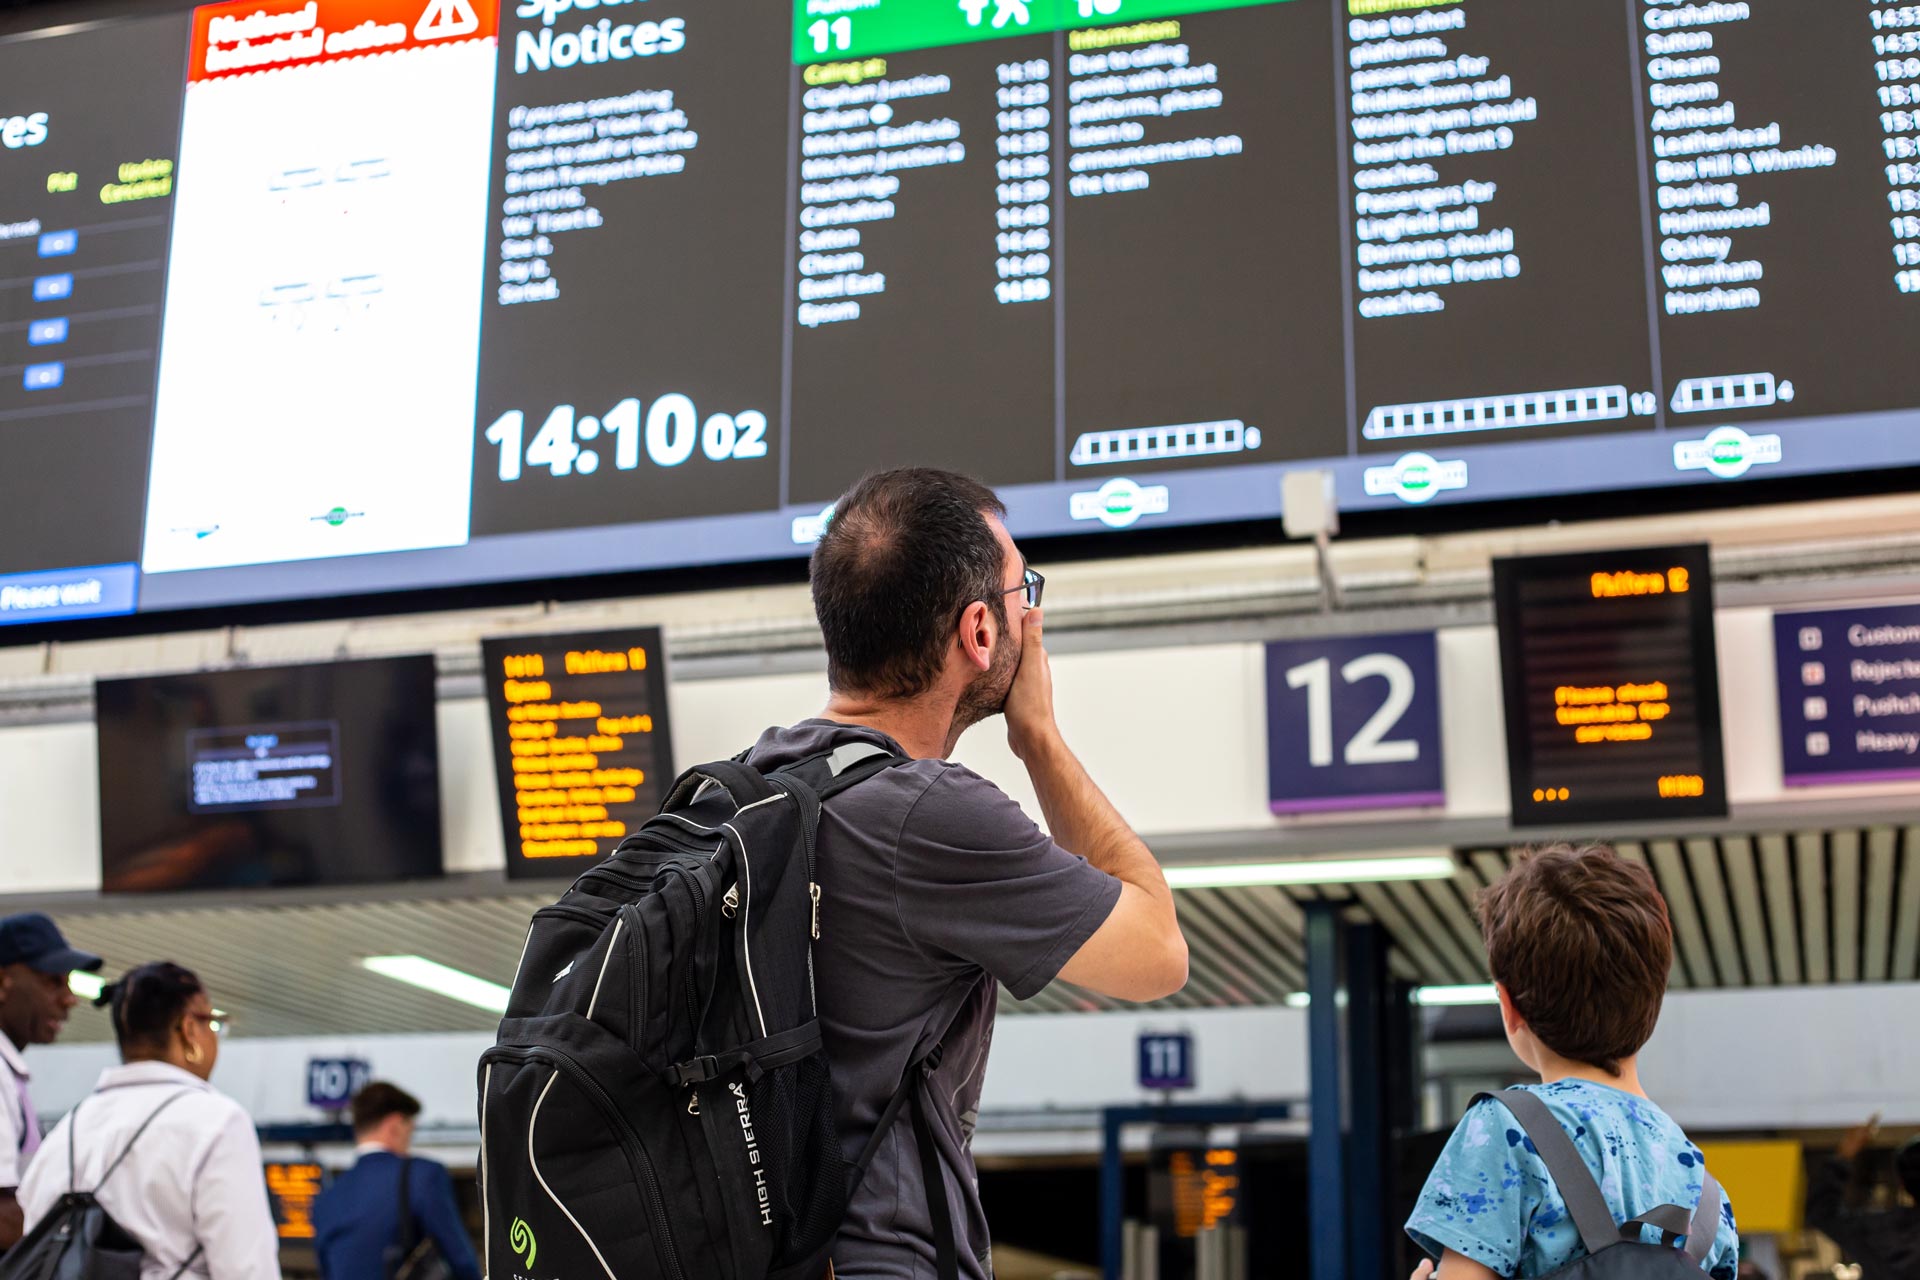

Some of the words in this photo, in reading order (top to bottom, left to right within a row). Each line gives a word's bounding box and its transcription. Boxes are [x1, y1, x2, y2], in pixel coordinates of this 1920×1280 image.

[806, 16, 852, 53] 11
[1349, 18, 1390, 40] Due
[1389, 16, 1415, 34] to
[515, 18, 686, 74] Notices
[1646, 30, 1714, 55] Sutton
[1648, 54, 1721, 80] Cheam
[1650, 80, 1719, 106] Epsom
[1652, 101, 1736, 129] Ashtead
[0, 112, 48, 149] es
[1654, 122, 1781, 157] Leatherhead
[1656, 158, 1697, 182] Box
[1658, 181, 1737, 209] Dorking
[1660, 202, 1771, 233] Holmwood
[1660, 236, 1733, 262] Ockley
[1662, 260, 1764, 287] Warnham
[1665, 286, 1761, 313] Horsham
[485, 392, 698, 482] 14:10
[700, 409, 769, 464] 02
[0, 584, 59, 612] Please
[1285, 652, 1420, 767] 12
[1855, 729, 1920, 755] Heavy
[1145, 1040, 1181, 1078] 11
[311, 1060, 348, 1092] 10
[756, 1167, 774, 1226] HIGH
